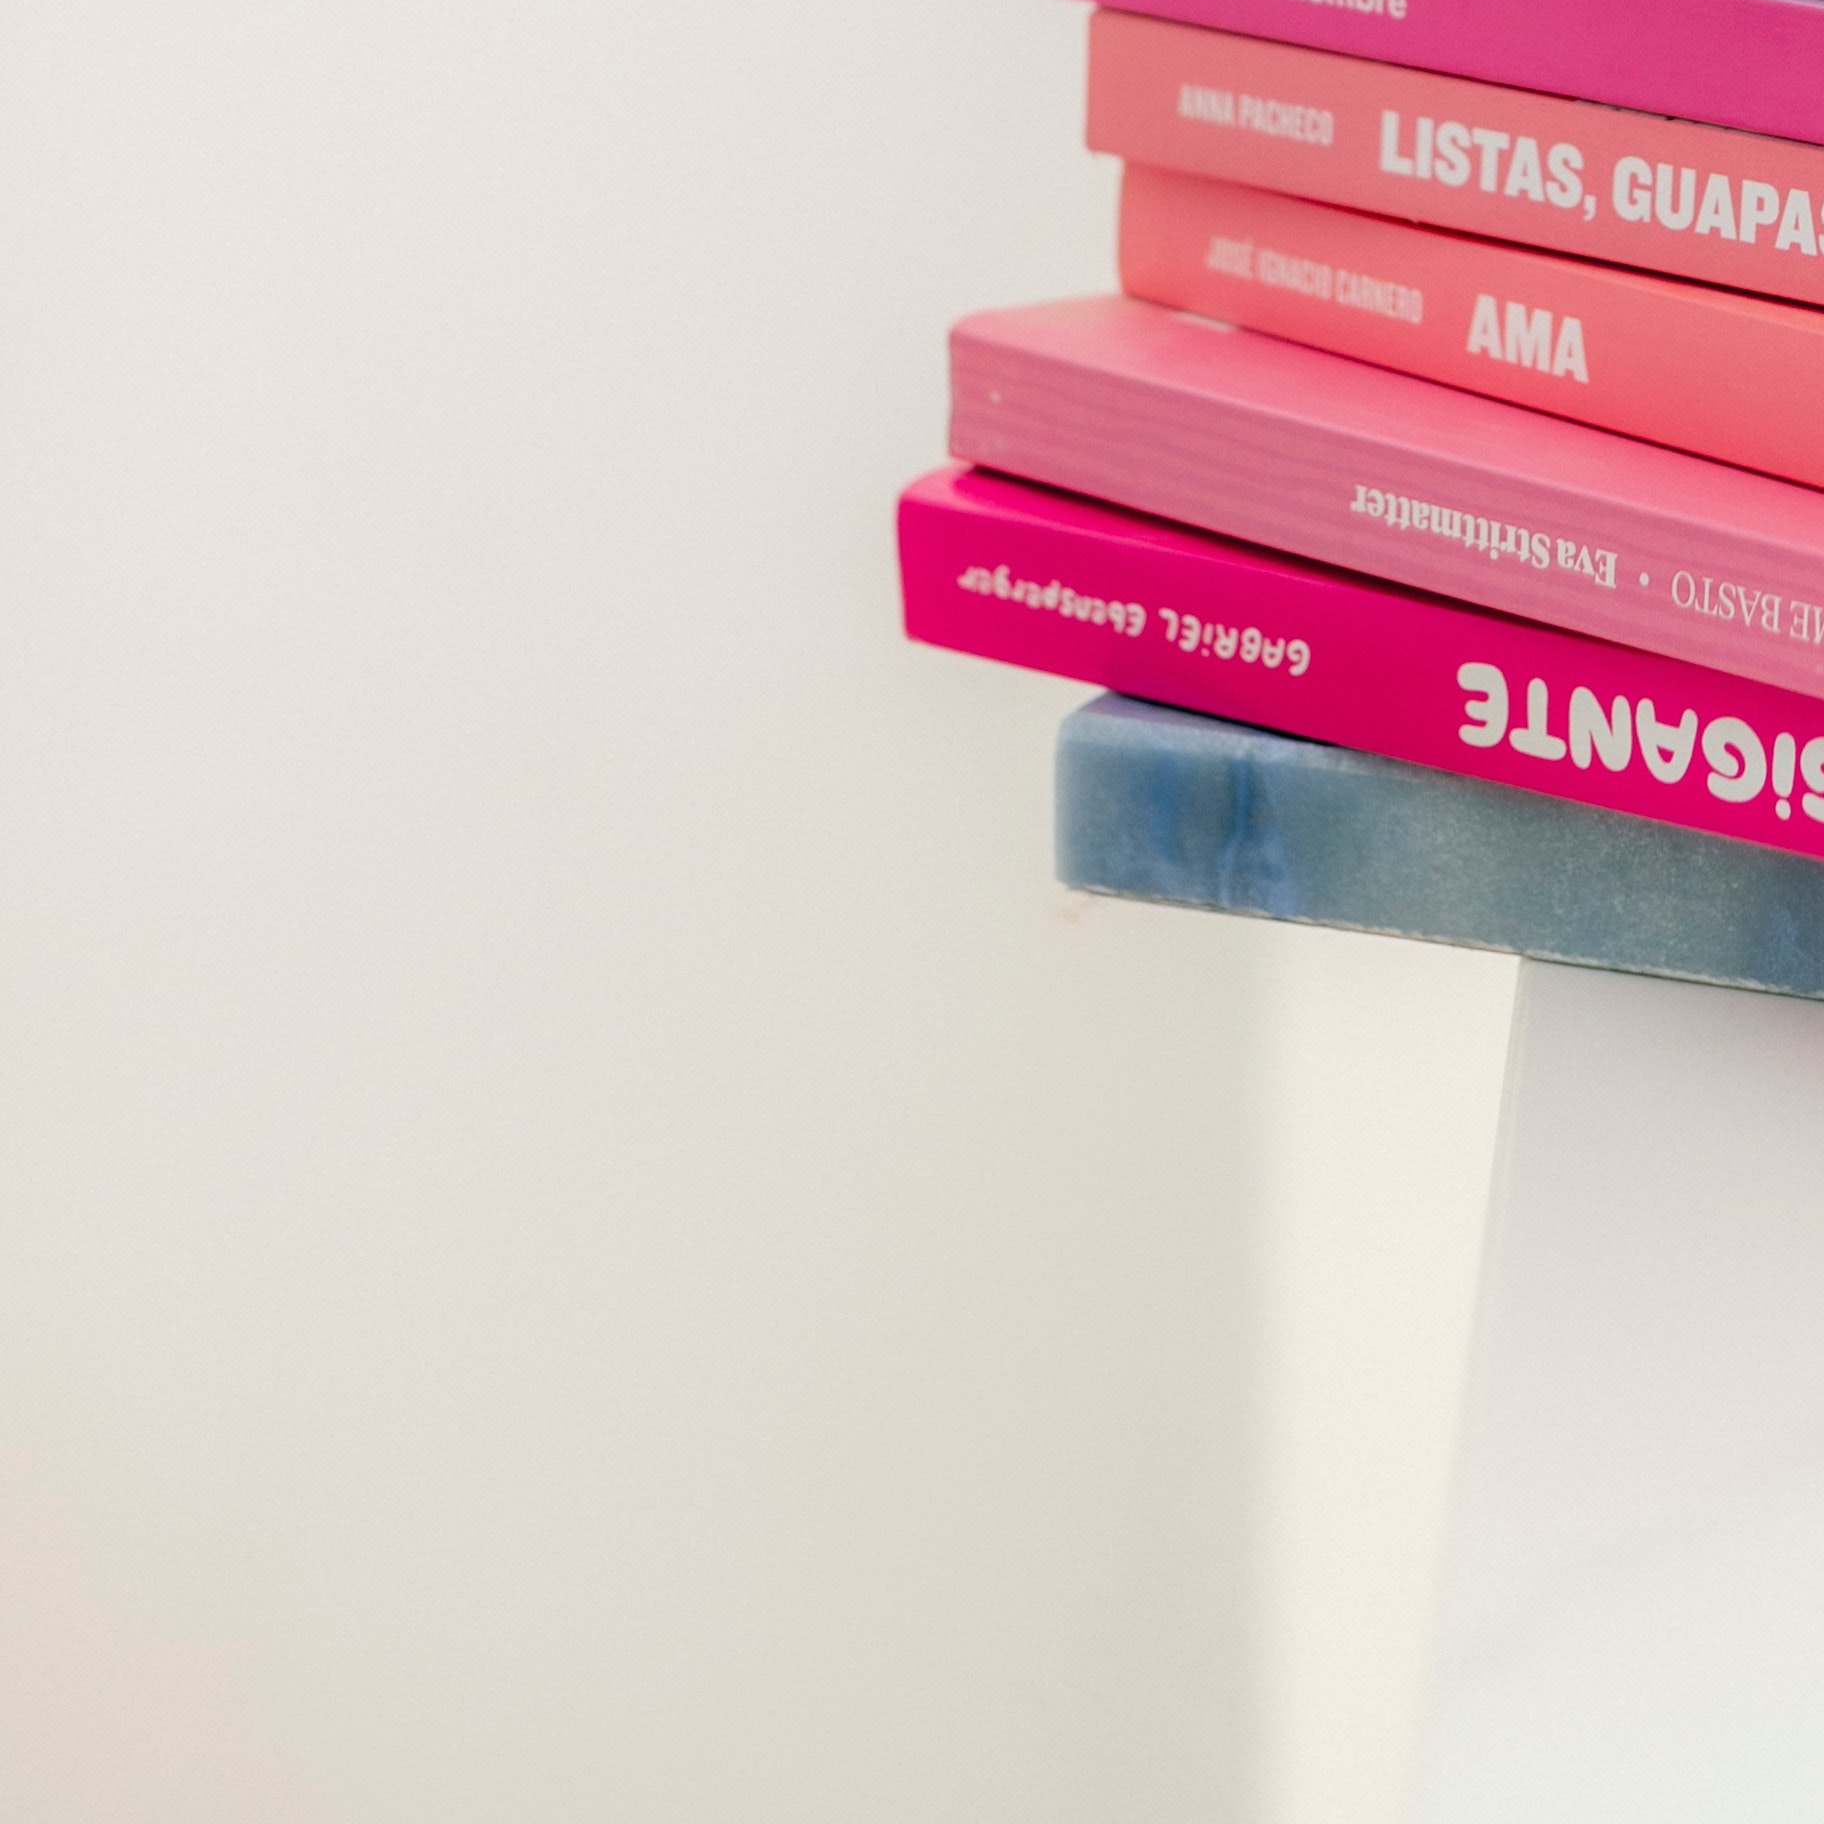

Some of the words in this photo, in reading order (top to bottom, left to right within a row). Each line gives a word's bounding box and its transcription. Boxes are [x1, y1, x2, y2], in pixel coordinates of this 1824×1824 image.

[1379, 109, 1598, 222] LISTAS,
[1466, 292, 1590, 384] AMA
[1349, 483, 1552, 571] Strittmatter
[1556, 537, 1619, 590] Eva
[1671, 569, 1783, 635] BASTO
